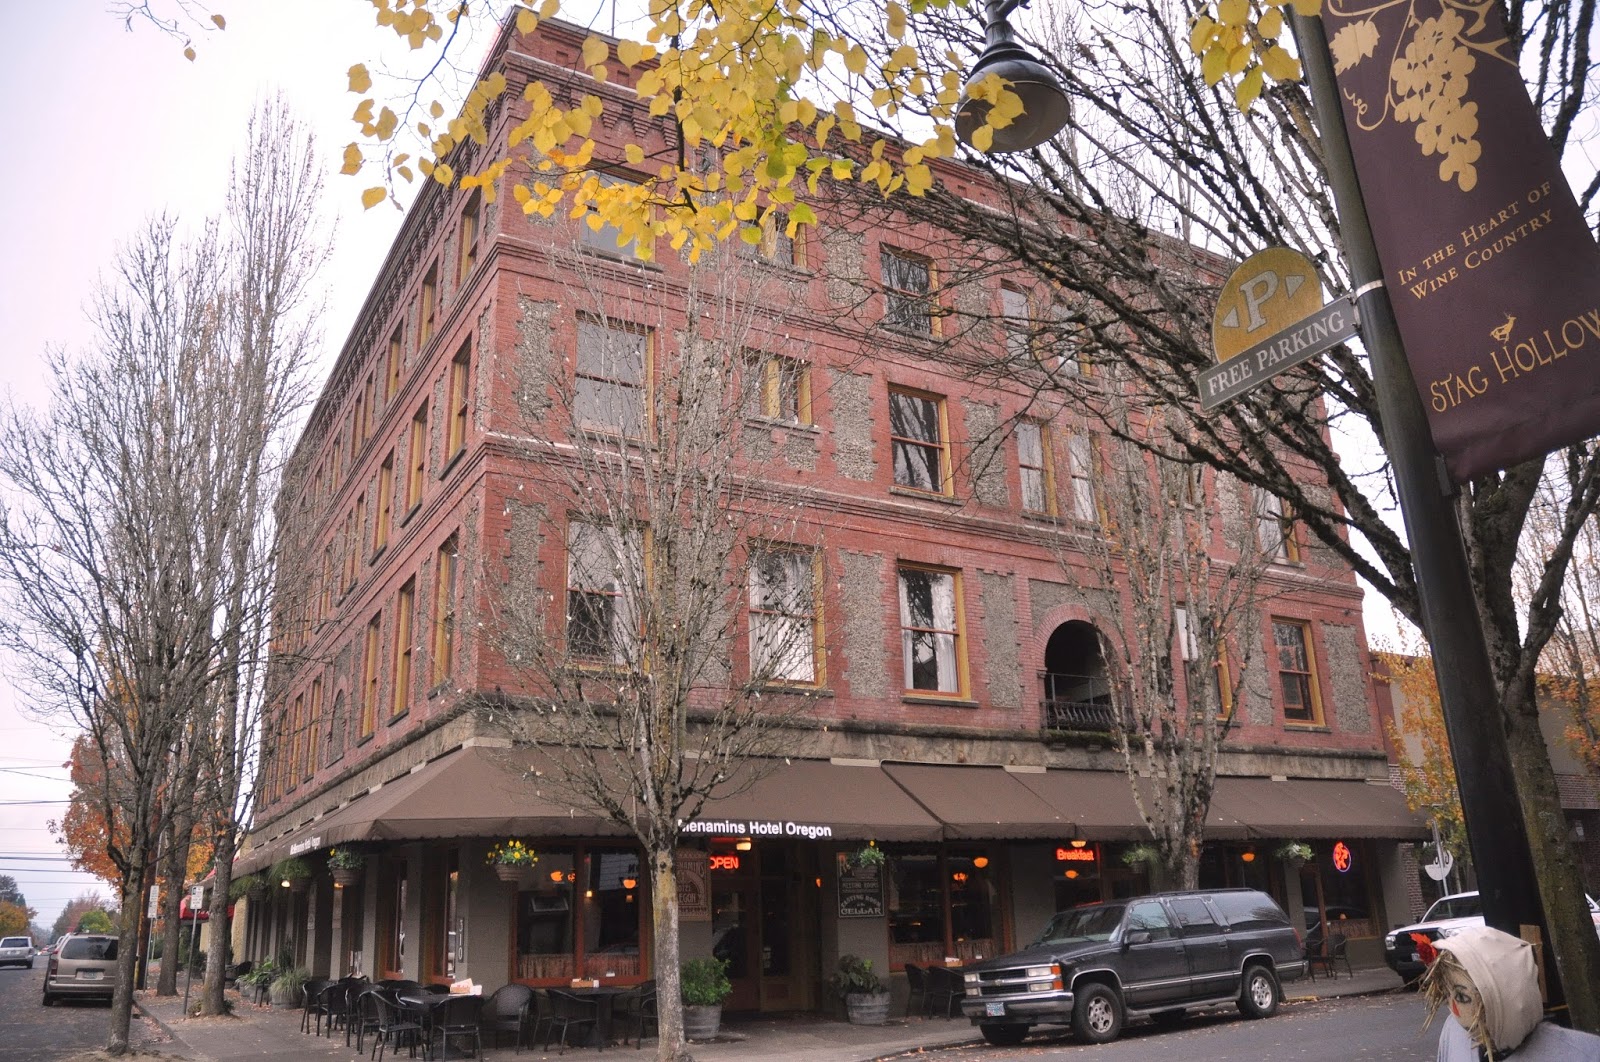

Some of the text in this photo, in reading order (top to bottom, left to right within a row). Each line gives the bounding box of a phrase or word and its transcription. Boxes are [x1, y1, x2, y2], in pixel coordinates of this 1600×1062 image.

[1239, 270, 1280, 334] P
[1207, 310, 1345, 397] FREE PARKING
[1430, 308, 1600, 413] STAG HOLLOW
[749, 821, 783, 835] Hotel
[785, 822, 832, 839] Oregon
[1056, 848, 1095, 861] Breakfast
[841, 907, 882, 915] CELLAR
